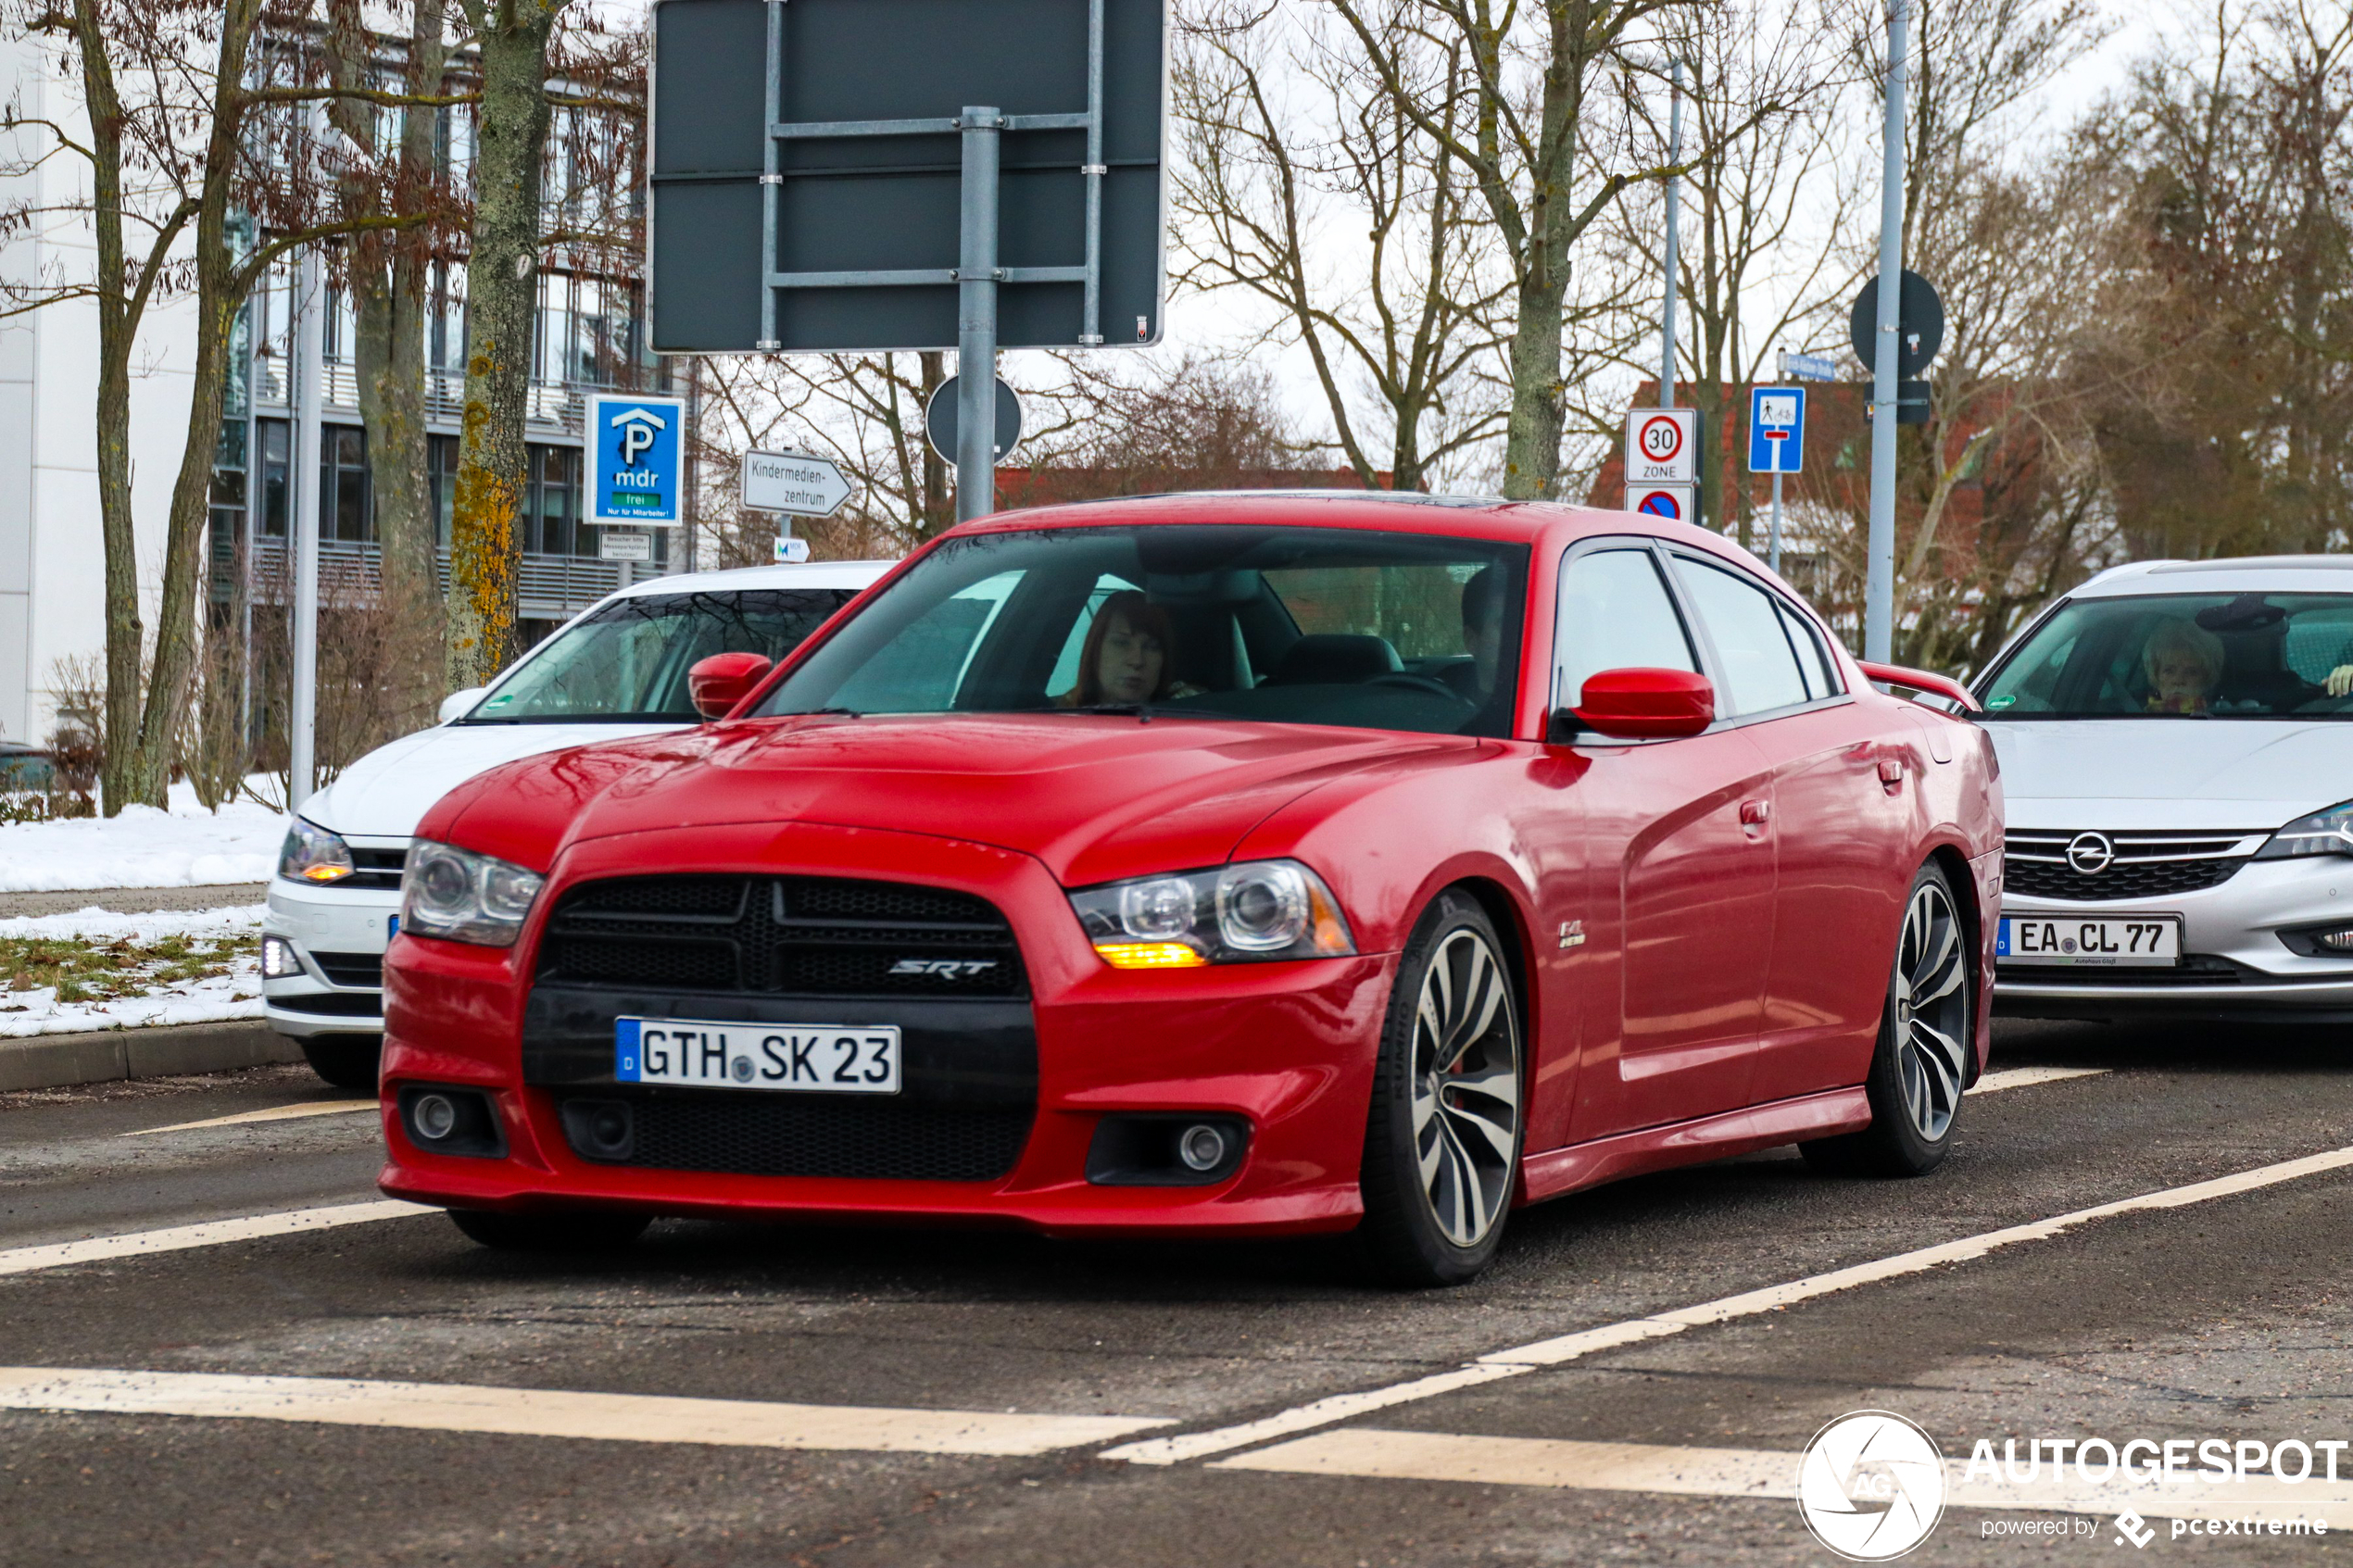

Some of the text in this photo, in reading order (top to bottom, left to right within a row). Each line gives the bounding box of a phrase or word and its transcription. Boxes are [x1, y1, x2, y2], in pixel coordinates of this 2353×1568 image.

[625, 423, 654, 465] P
[1648, 429, 1673, 450] 30
[615, 469, 660, 488] mdr
[751, 460, 826, 484] Kindermedien-
[1643, 466, 1677, 478] ZONE
[626, 493, 646, 506] frei
[784, 490, 825, 507] zentrum
[607, 507, 669, 518] Nur für Mitarbeiter!
[1998, 922, 2164, 953] D EA CL 77
[887, 960, 998, 980] SRT
[623, 1030, 890, 1084] D GTH SK 23
[1394, 1001, 1408, 1100] KUMHO
